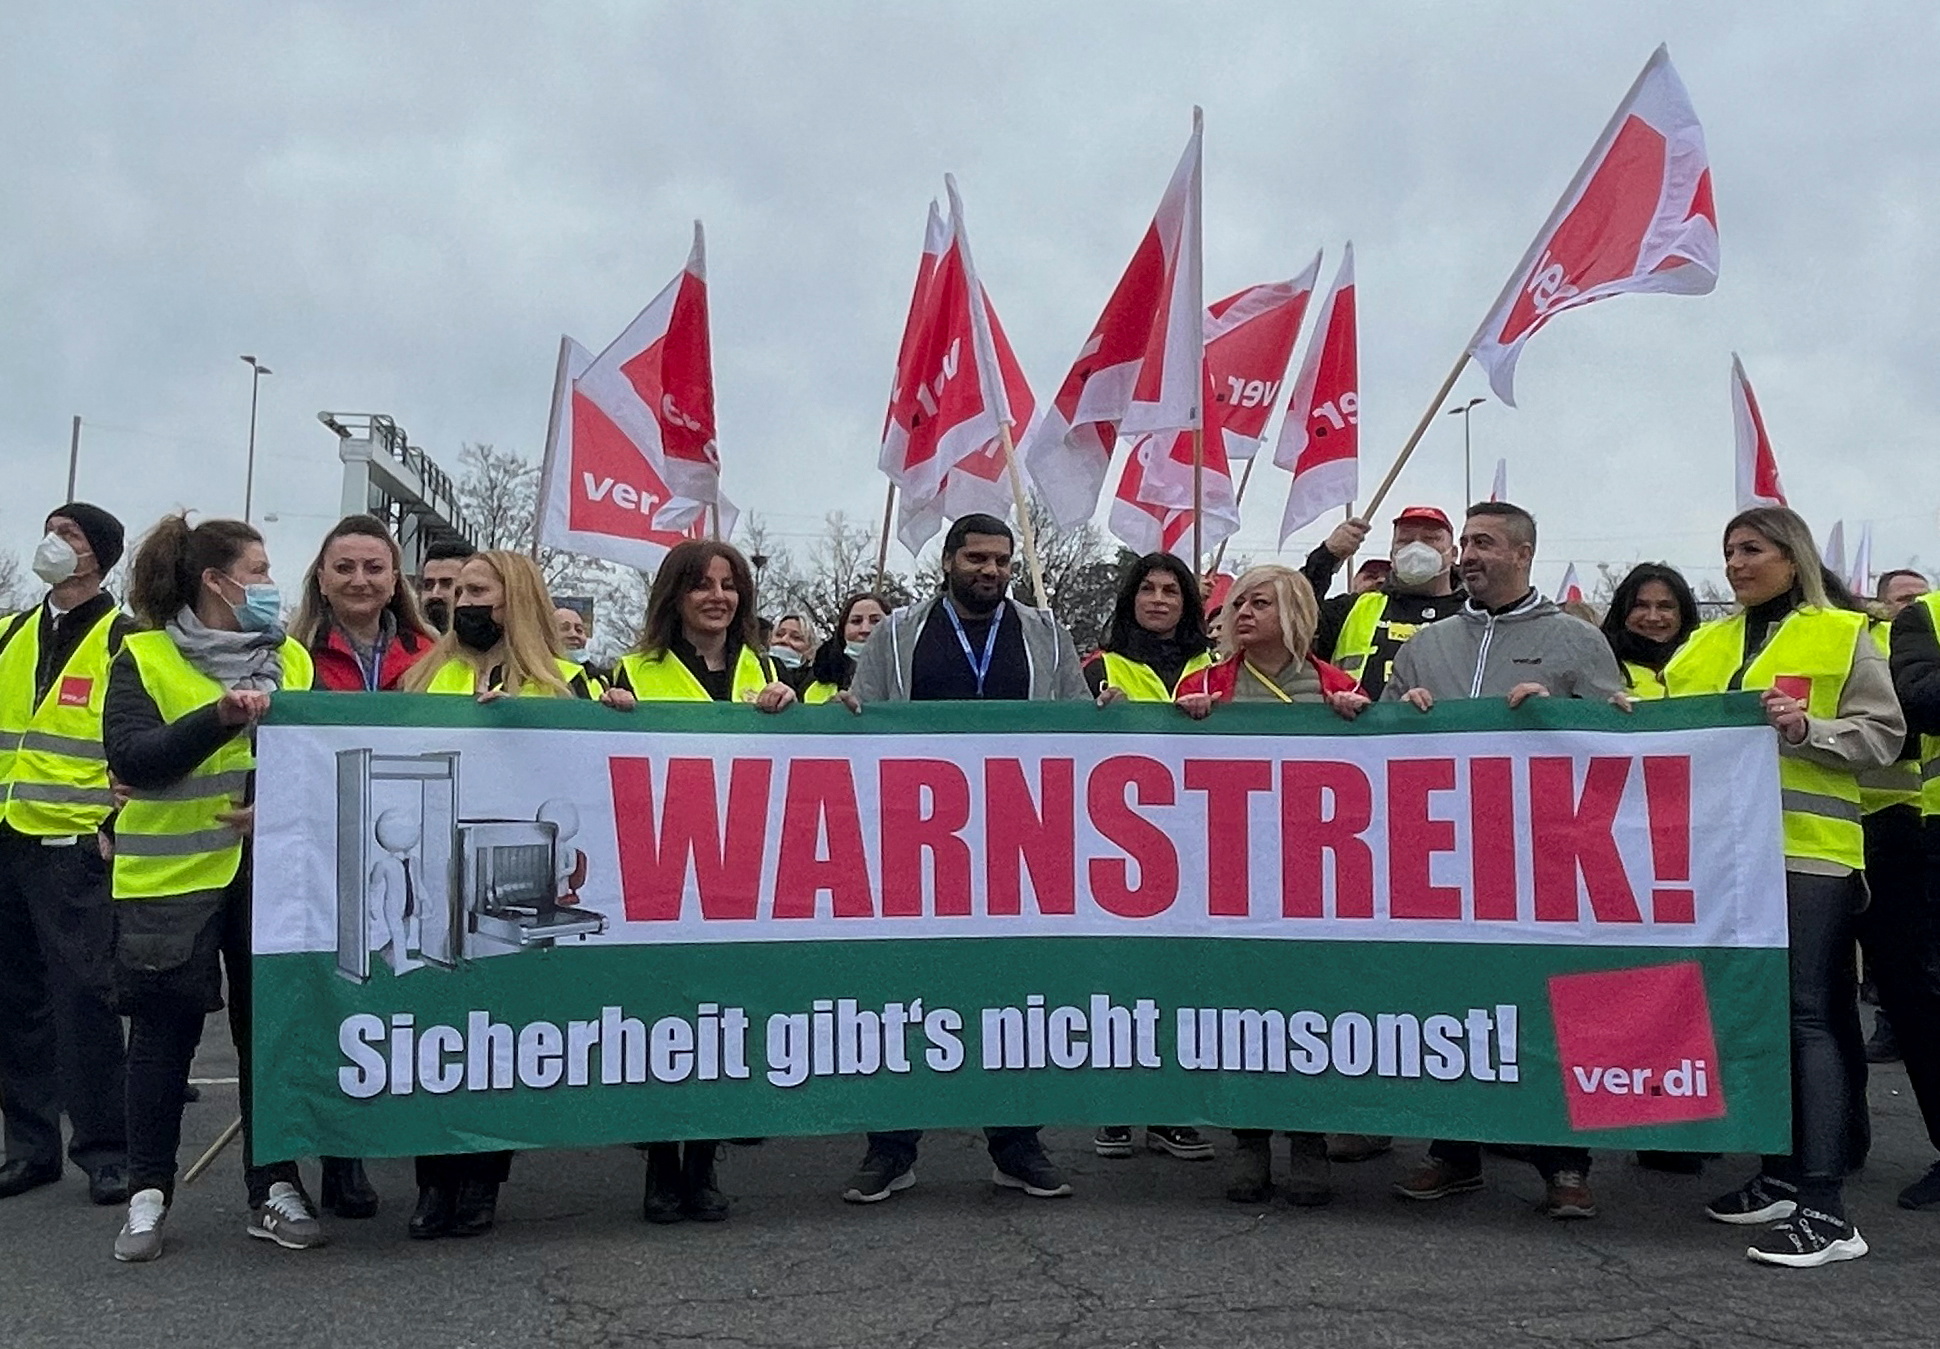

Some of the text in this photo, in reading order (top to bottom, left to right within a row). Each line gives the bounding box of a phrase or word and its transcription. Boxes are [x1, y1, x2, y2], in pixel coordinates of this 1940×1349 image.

[583, 472, 660, 516] ver
[610, 756, 1694, 923] WARNSTREIK!
[337, 1005, 751, 1099] Sicherheit
[982, 994, 1161, 1071] nicht
[1177, 1003, 1519, 1084] umsonst!
[1572, 1058, 1708, 1097] ver.di
